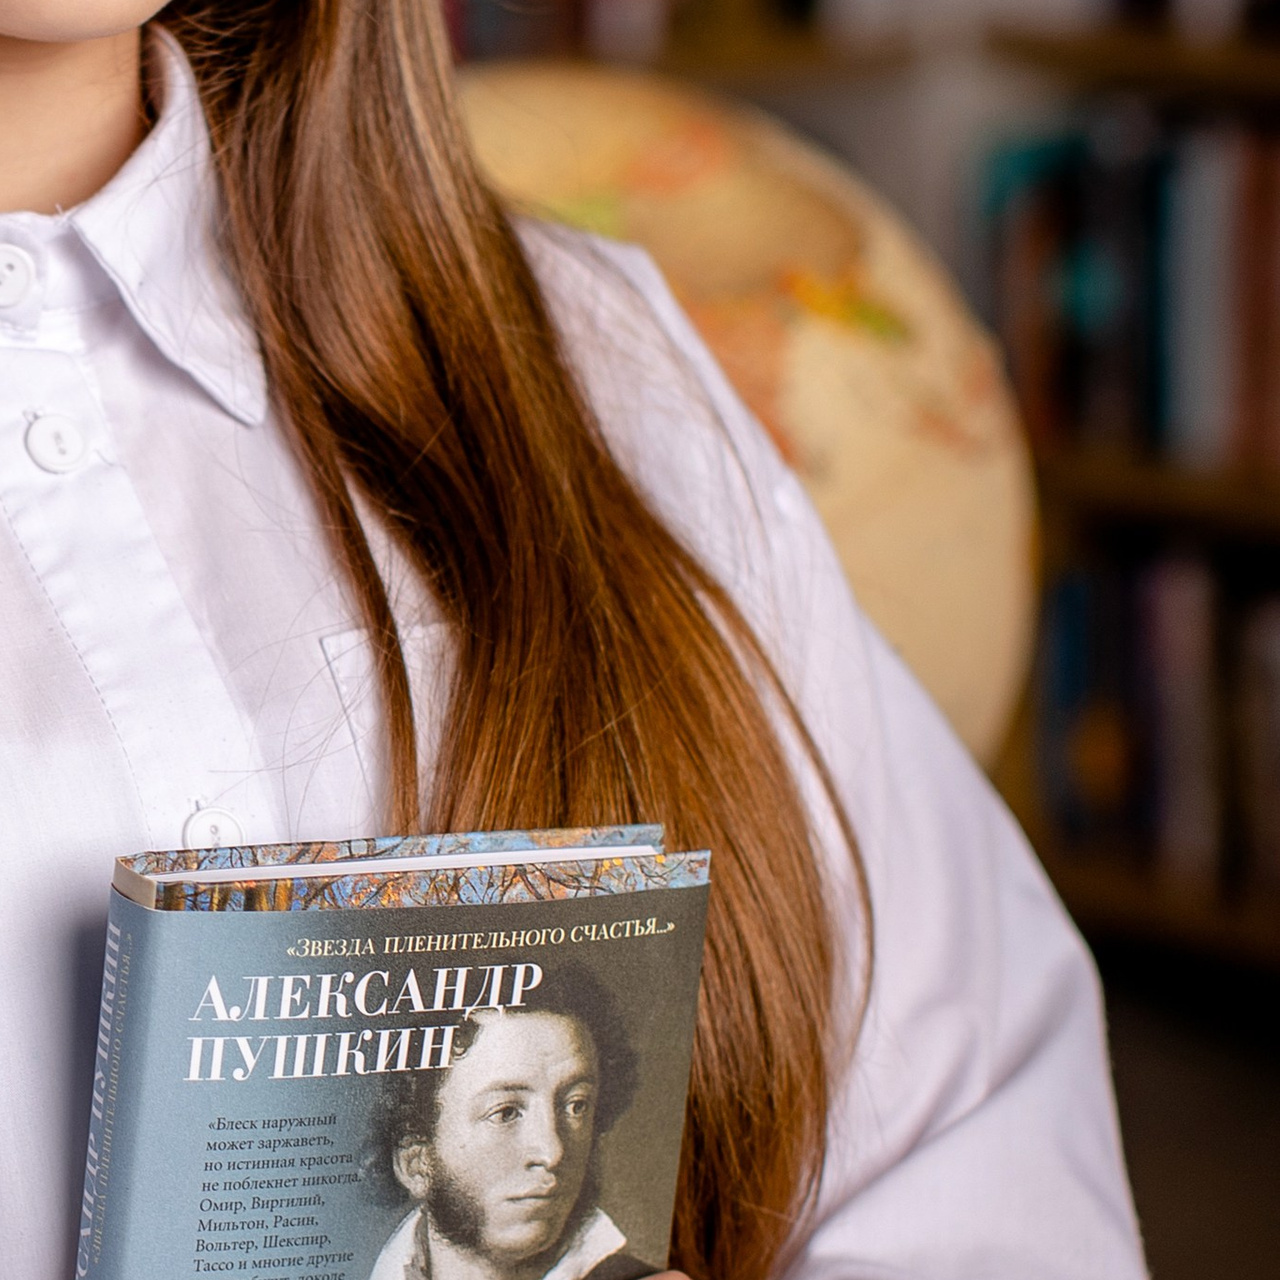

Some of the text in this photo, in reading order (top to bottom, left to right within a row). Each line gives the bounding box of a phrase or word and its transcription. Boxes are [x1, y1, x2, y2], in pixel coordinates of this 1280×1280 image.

[286, 937, 375, 958] «ЗВЕЗДА
[383, 927, 566, 955] ПЛЕНИТЕЛЬНОГО
[188, 962, 544, 1022] АЛЕКСАНДР
[183, 1025, 461, 1082] ПУШКИН
[208, 1113, 337, 1133] «Блеск наружный
[206, 1134, 334, 1153] может заржаветь,
[204, 1153, 354, 1172] но истинная красота
[202, 1171, 362, 1192] не поблекнет никогда.
[199, 1194, 325, 1215] Омир, Виргилий,
[197, 1214, 319, 1233] Мильтон, Расин,
[195, 1233, 331, 1255] Вольтер, Шекспир,
[193, 1251, 355, 1273] Тассо и многие другие
